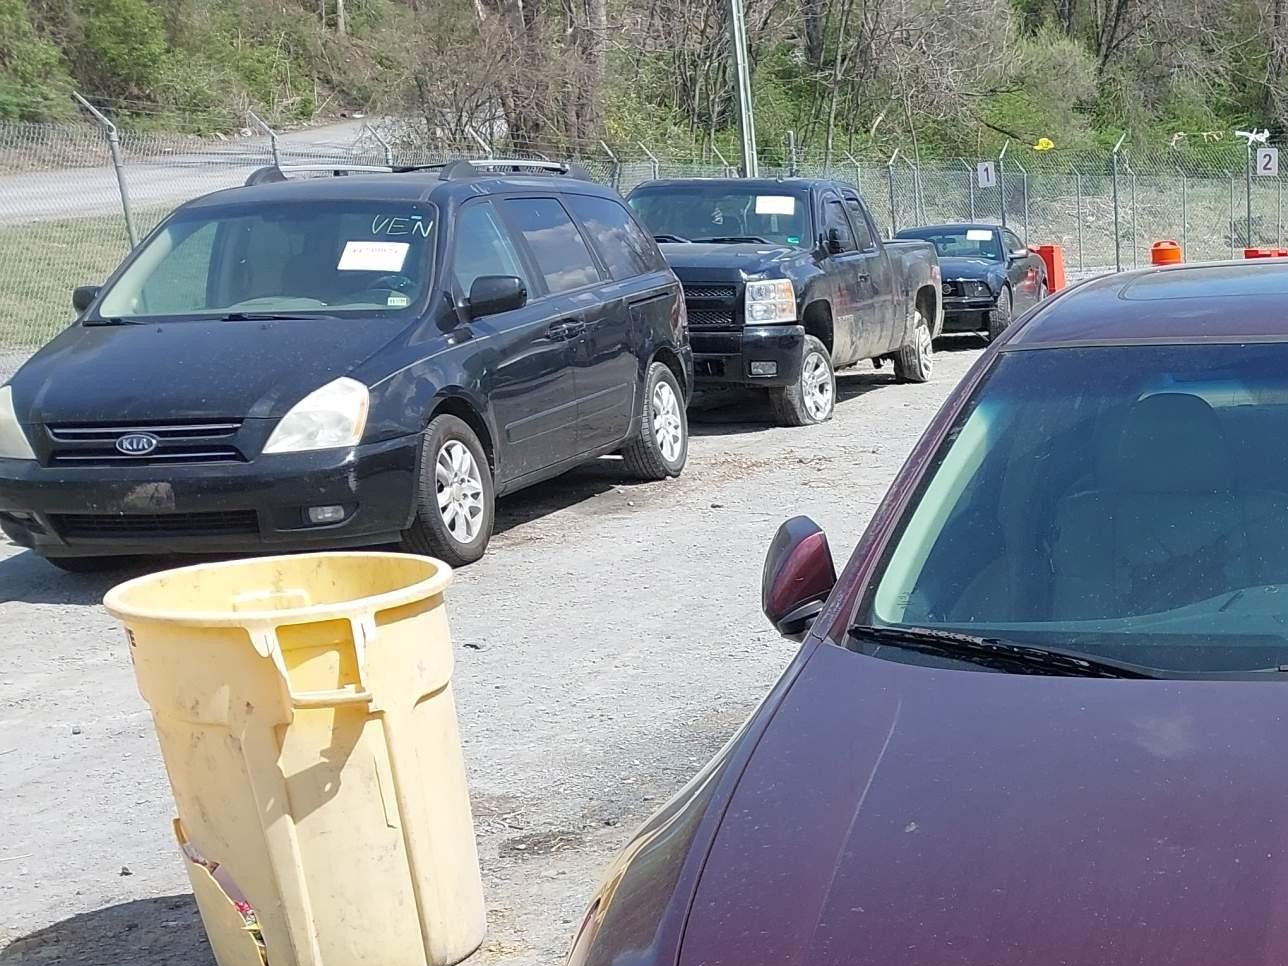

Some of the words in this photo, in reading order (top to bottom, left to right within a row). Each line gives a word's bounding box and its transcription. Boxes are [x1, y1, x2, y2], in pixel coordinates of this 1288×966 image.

[1262, 153, 1273, 171] 2
[983, 166, 990, 182] 1
[122, 438, 149, 450] KIA
